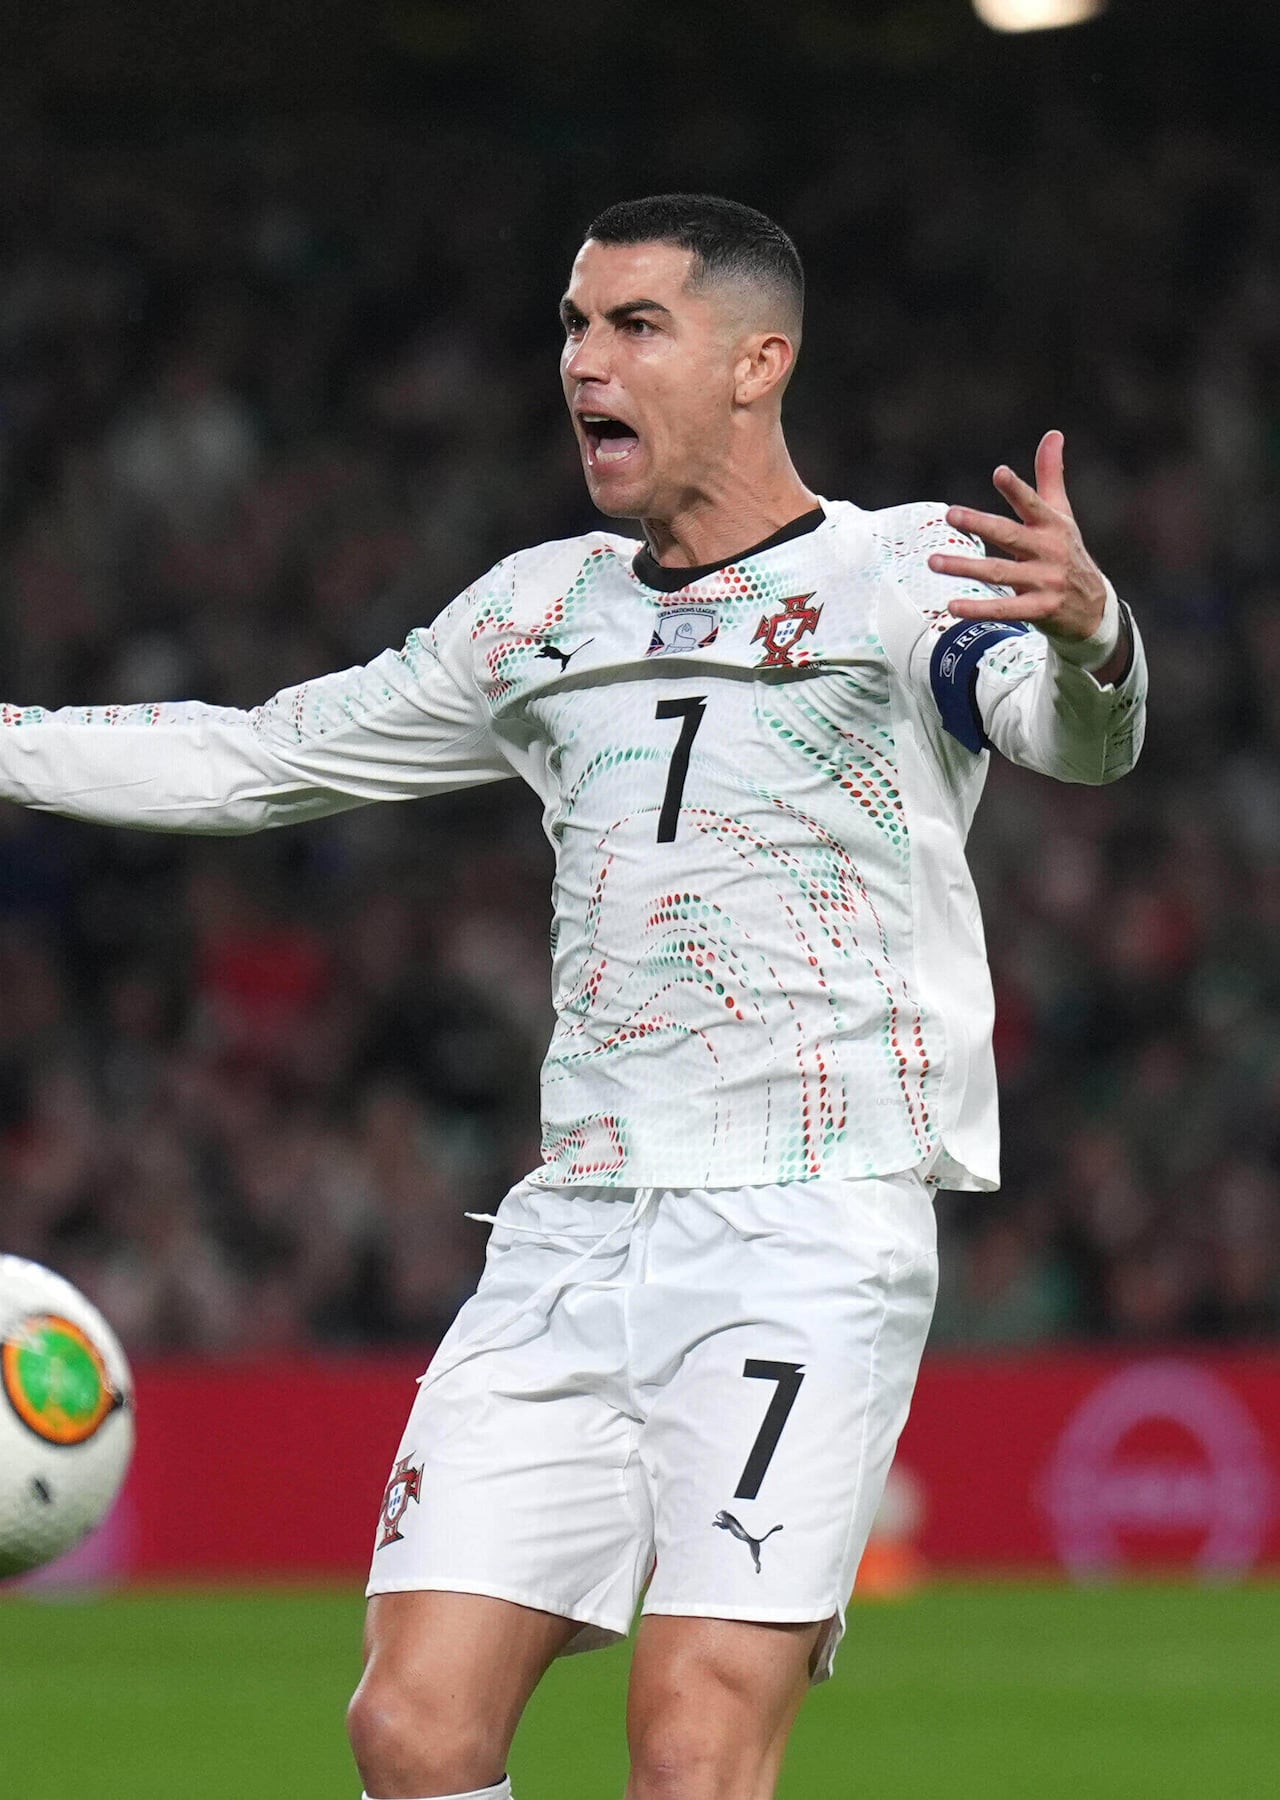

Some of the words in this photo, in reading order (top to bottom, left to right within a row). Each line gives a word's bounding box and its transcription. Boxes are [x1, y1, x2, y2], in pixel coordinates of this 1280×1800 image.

[696, 607, 717, 615] LEAGUE
[655, 695, 708, 843] 7
[734, 1358, 806, 1499] 7
